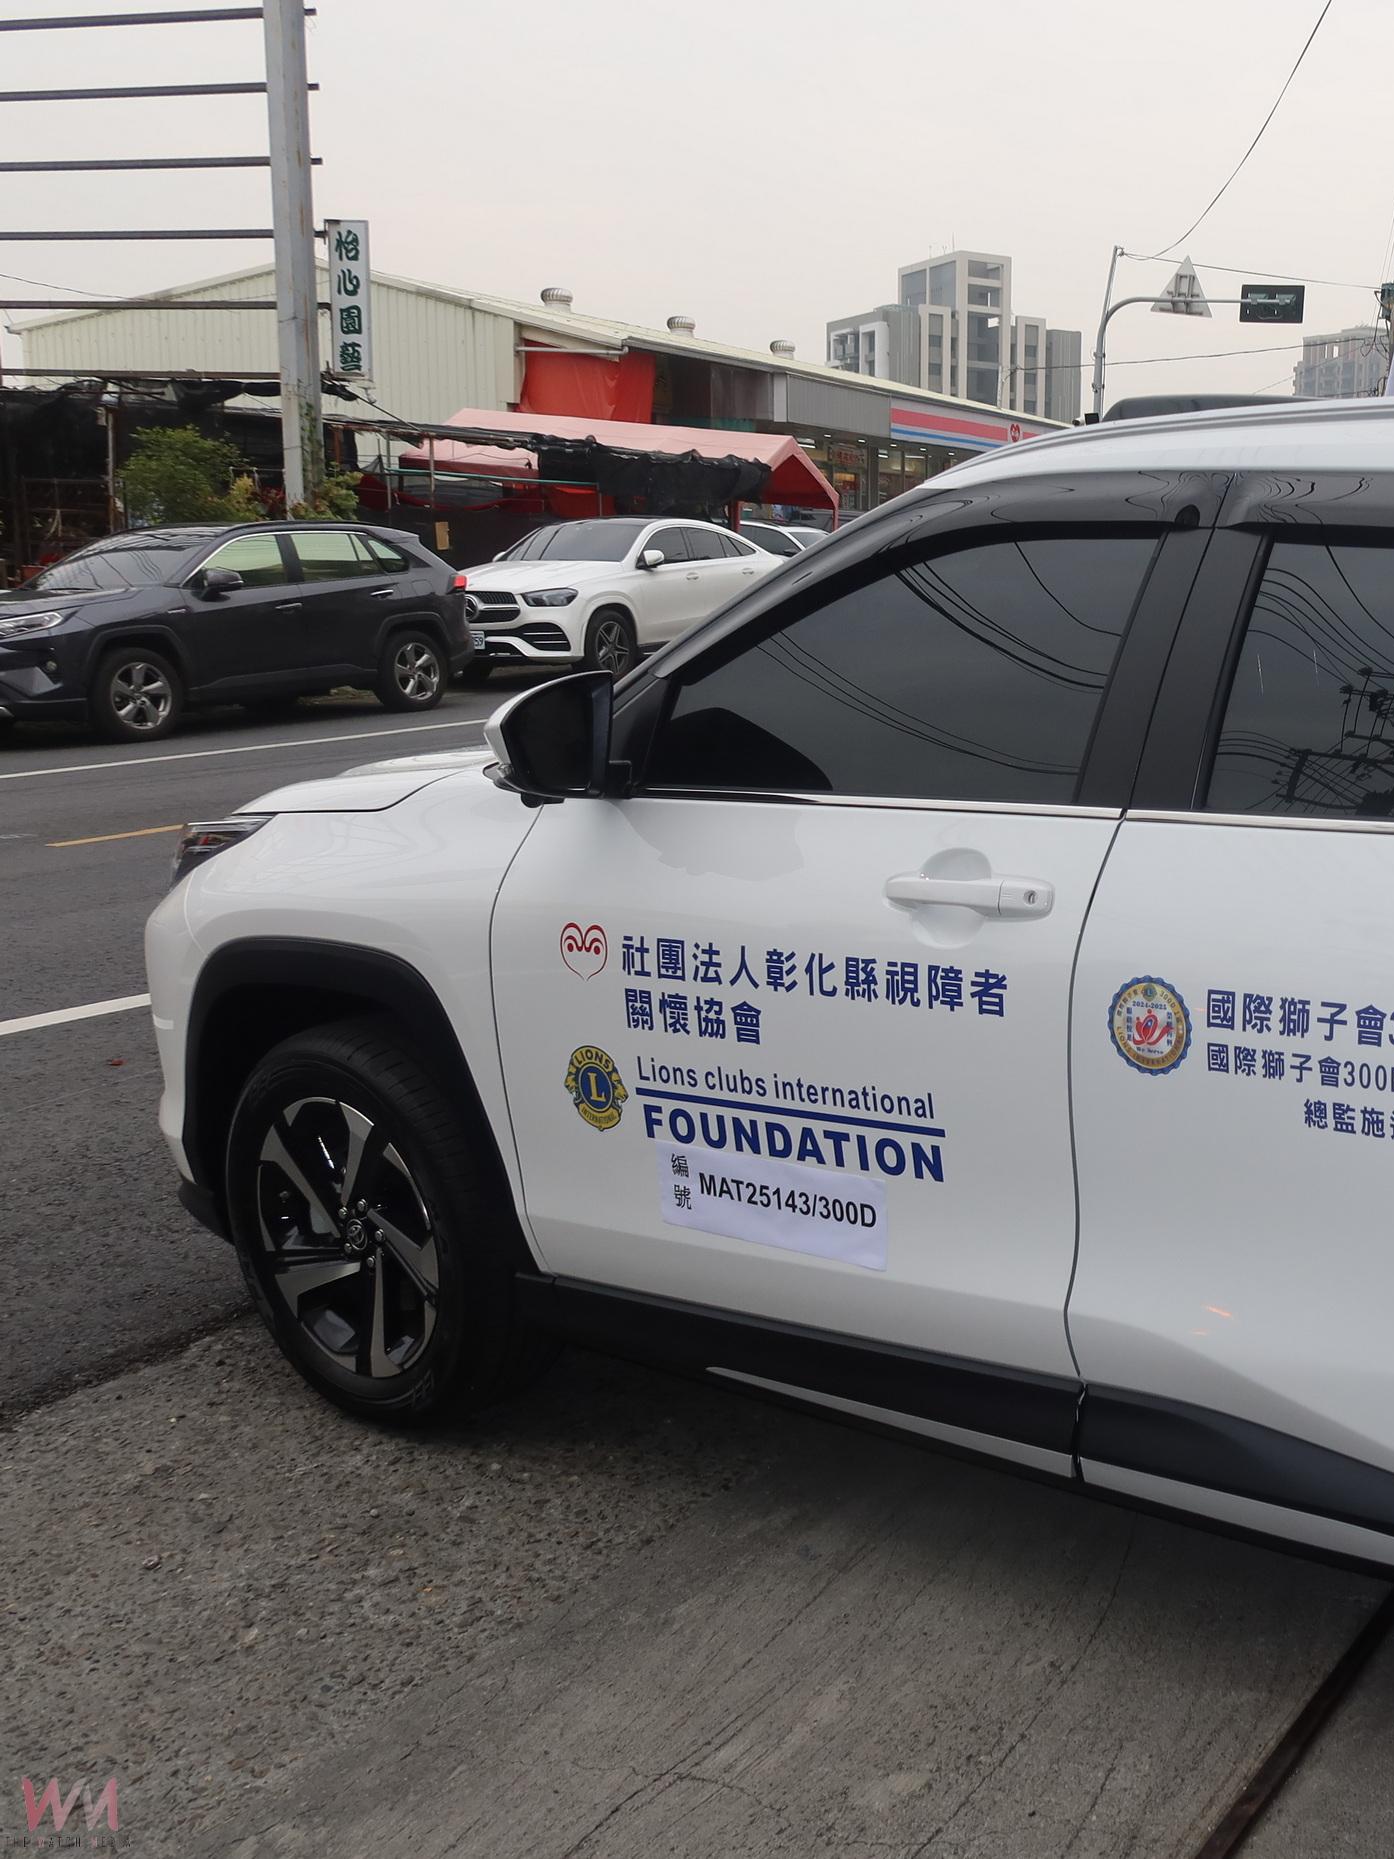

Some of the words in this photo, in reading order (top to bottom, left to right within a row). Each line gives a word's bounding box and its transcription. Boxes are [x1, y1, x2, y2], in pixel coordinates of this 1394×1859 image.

[335, 229, 362, 372] 怡心園藝
[621, 936, 1007, 1017] 社團法人彰化縣視障者
[624, 988, 761, 1045] 關懷協會
[574, 1049, 612, 1070] LIONS
[587, 1072, 606, 1102] L
[636, 1055, 698, 1088] Lions
[704, 1065, 768, 1098] clubs
[773, 1073, 934, 1120] international
[643, 1104, 944, 1182] FOUNDATION
[671, 1153, 692, 1210] 編號
[699, 1172, 877, 1228] MAT25143/300D
